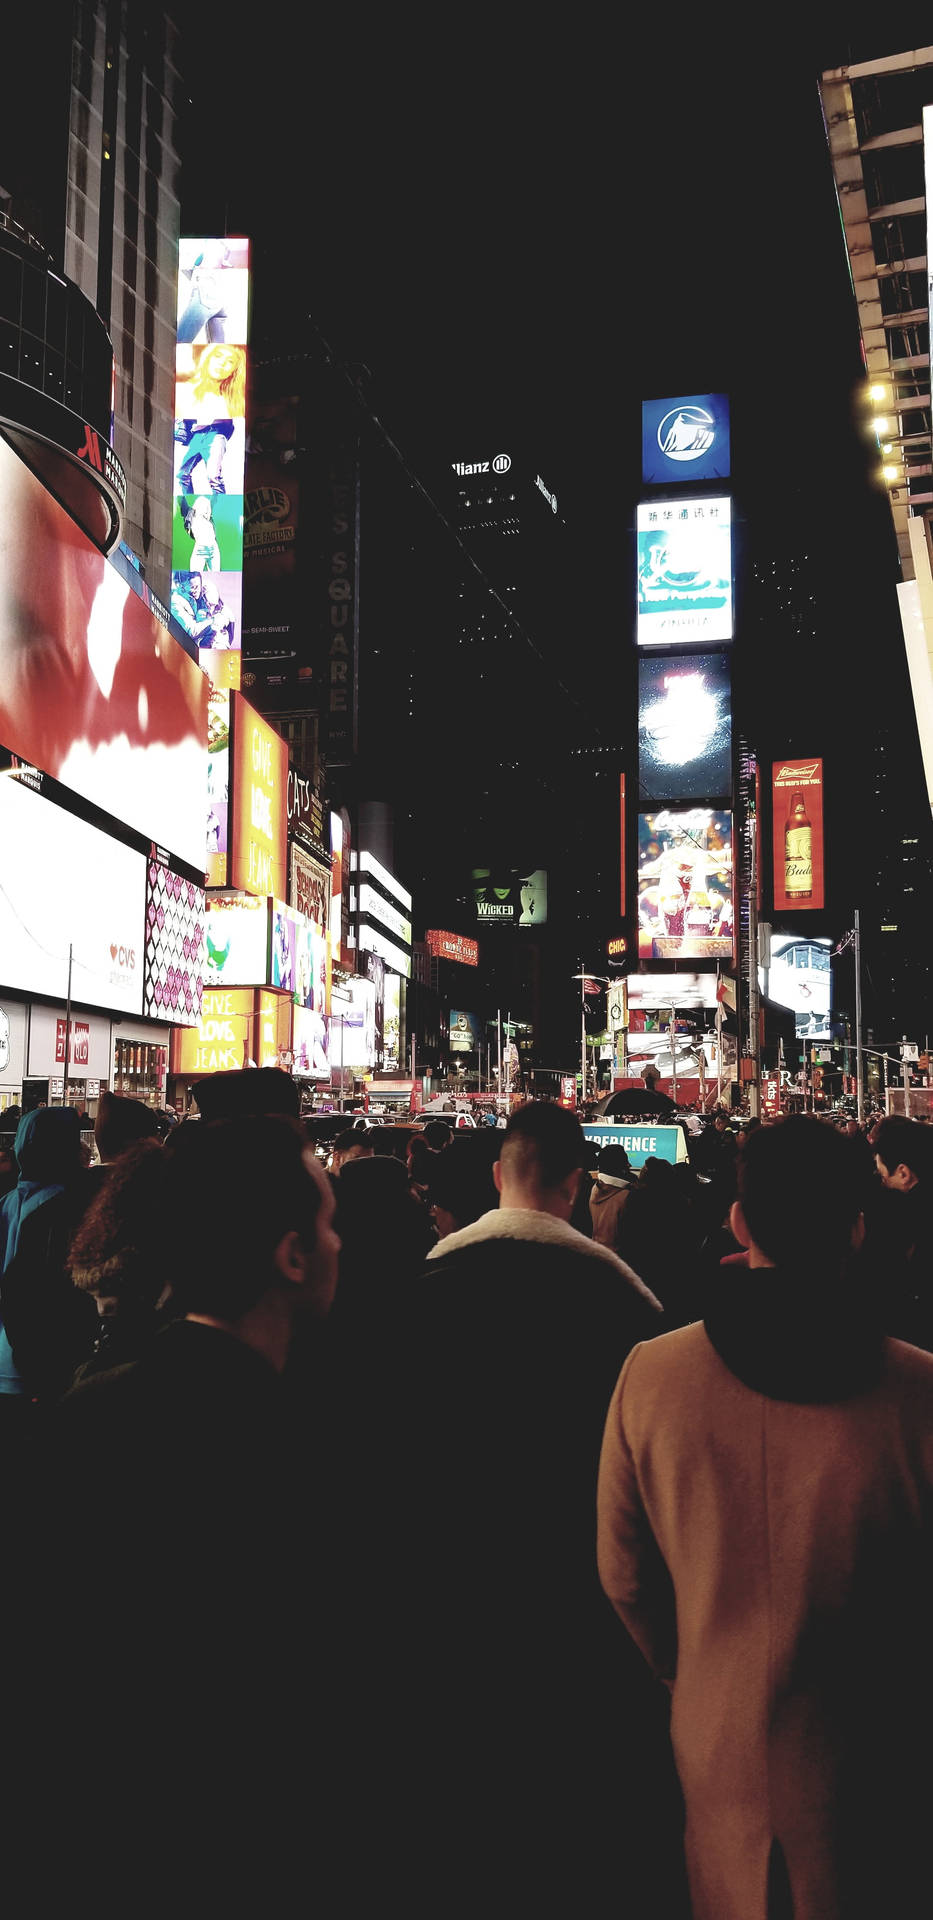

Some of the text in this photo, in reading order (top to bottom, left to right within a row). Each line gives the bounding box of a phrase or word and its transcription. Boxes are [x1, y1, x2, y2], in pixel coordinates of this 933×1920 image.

[452, 462, 490, 476] lianz
[328, 551, 352, 712] SQUARE
[252, 727, 274, 788] GIVE
[287, 770, 310, 819] CATS
[118, 945, 136, 970] CVS
[201, 994, 236, 1015] GIVE
[199, 1020, 236, 1041] LOVE
[194, 1047, 241, 1069] JEANS
[767, 1081, 777, 1100] tkts
[585, 1136, 657, 1152] PERIENCE
